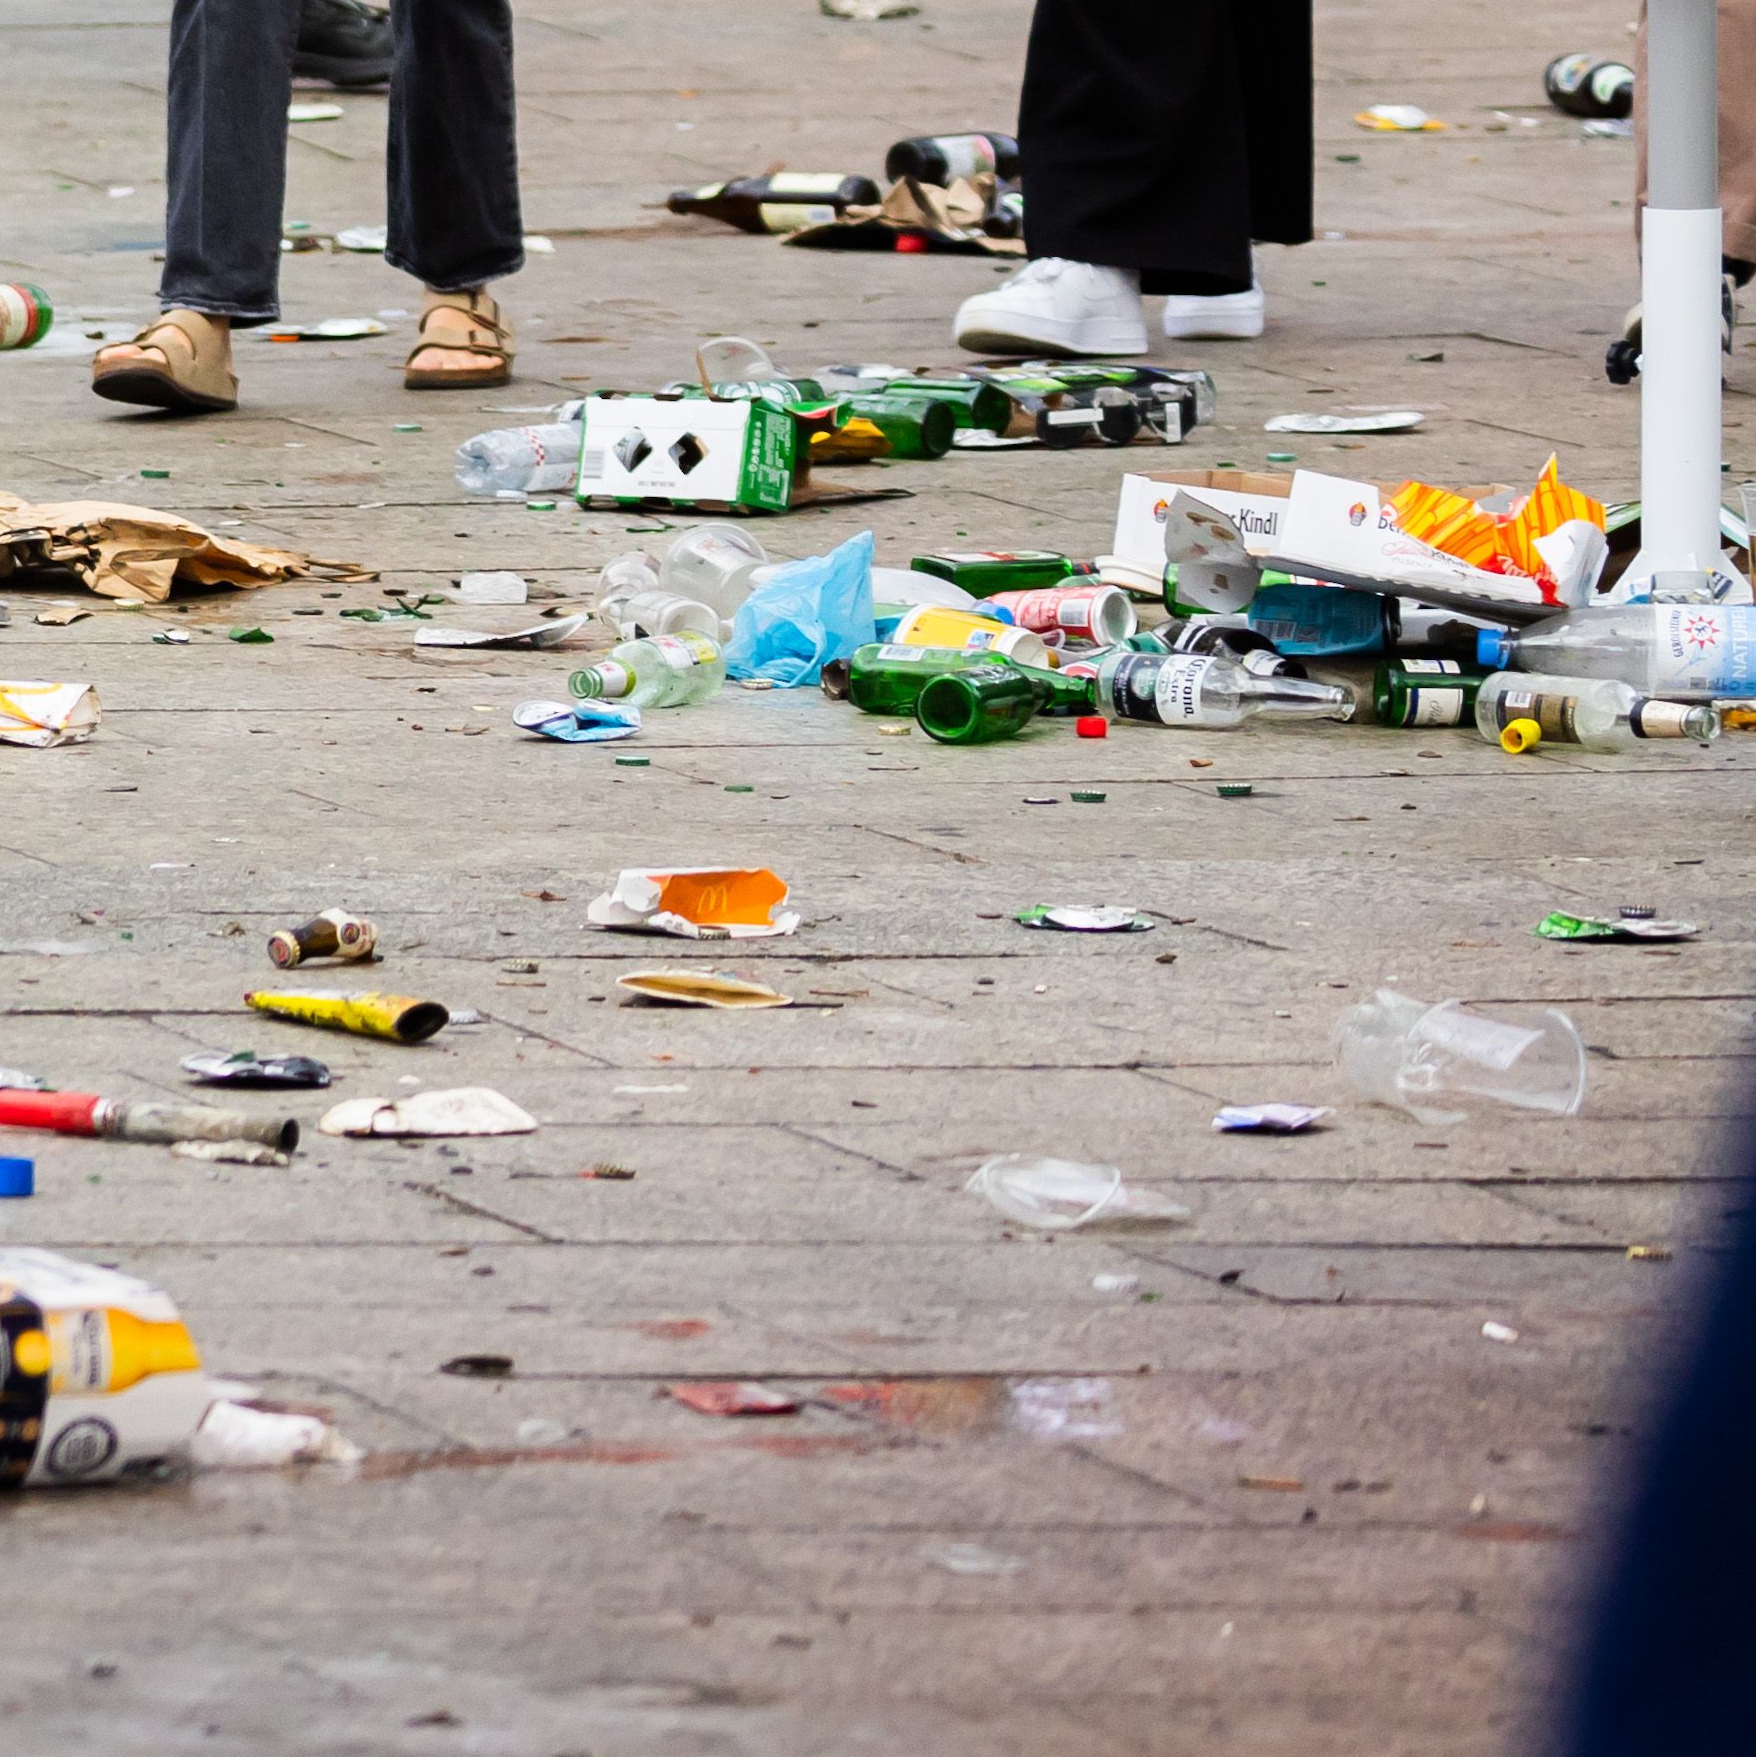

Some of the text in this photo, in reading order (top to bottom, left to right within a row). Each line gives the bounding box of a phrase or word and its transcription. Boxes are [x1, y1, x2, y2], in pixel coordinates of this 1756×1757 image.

[1238, 507, 1278, 536] Kindl
[1171, 668, 1186, 703] Extra
[1182, 658, 1207, 718] Corona
